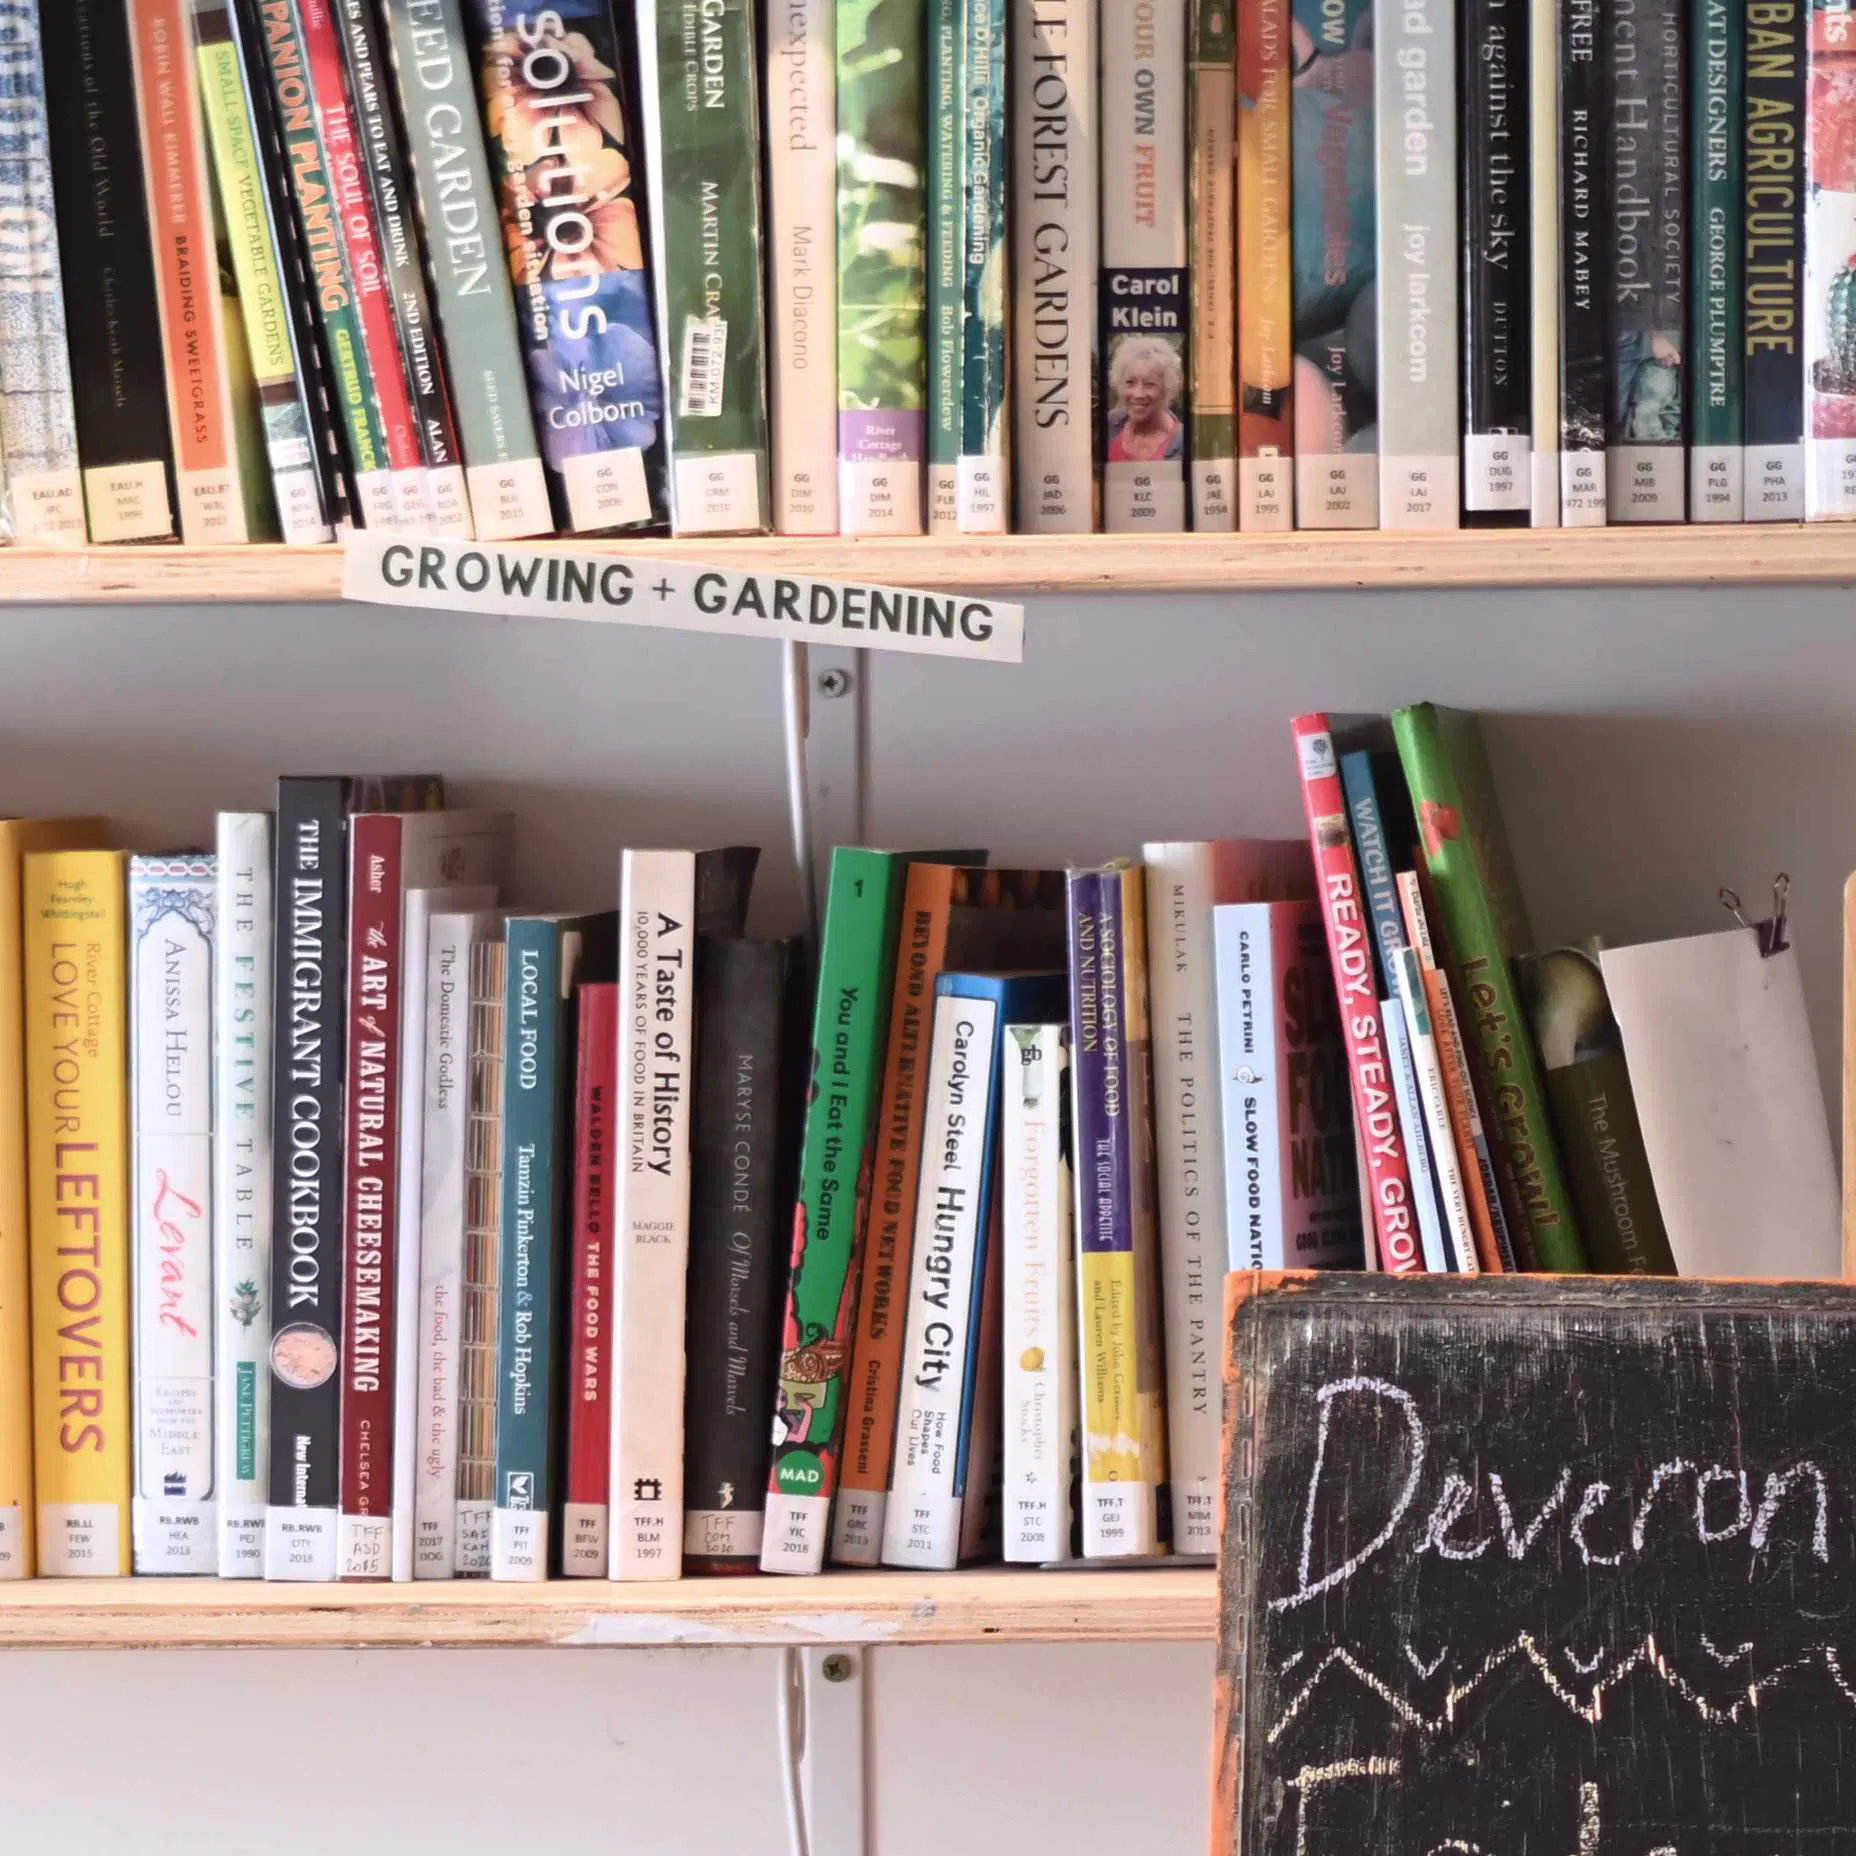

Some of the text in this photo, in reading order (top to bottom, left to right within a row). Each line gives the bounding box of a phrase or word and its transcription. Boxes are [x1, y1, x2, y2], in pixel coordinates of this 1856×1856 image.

[515, 8, 608, 341] solutions
[1482, 25, 1516, 271] against the sky
[1707, 37, 1730, 183] DESIGNERS
[289, 140, 348, 313] PLANTING
[425, 104, 492, 298] GARDEN
[699, 182, 719, 267] MARTIN
[1032, 54, 1070, 430] FOREST GARDENS
[1397, 46, 1435, 385] garden joy larkcom
[1614, 97, 1652, 303] Handbook
[1746, 97, 1796, 356] AGRICULTURE
[174, 237, 209, 445] BRAIDING SWEETGRASS
[1111, 275, 1179, 296] Carol
[1111, 306, 1178, 327] Klein
[550, 401, 644, 429] Colborn
[560, 364, 626, 394] Nigel
[381, 544, 635, 606] GROWING
[692, 572, 995, 642] GARDENING
[288, 819, 324, 1310] THE IMMIGRANT COOKBOOK
[360, 955, 389, 1011] ART
[518, 949, 540, 1090] LOCAL FOOD
[650, 913, 683, 1178] A Taste of History
[832, 1033, 850, 1076] and
[837, 986, 859, 1028] You
[355, 1040, 387, 1168] NATURAL
[822, 1133, 847, 1169] the
[829, 1090, 849, 1127] Eat
[51, 942, 106, 1454] LOVE YOUR LEFTOVERS
[152, 1167, 204, 1340] Levant
[816, 1171, 840, 1242] Same
[917, 1021, 975, 1392] Carolyn Steel Hungry City
[351, 1175, 385, 1394] CHEESEMAKING
[513, 1210, 536, 1416] Pinkerton & Rob Hopkins
[582, 1241, 601, 1402] THE FOOD WARS
[779, 1467, 819, 1482] MAD
[1267, 1374, 1834, 1611] Deveron
